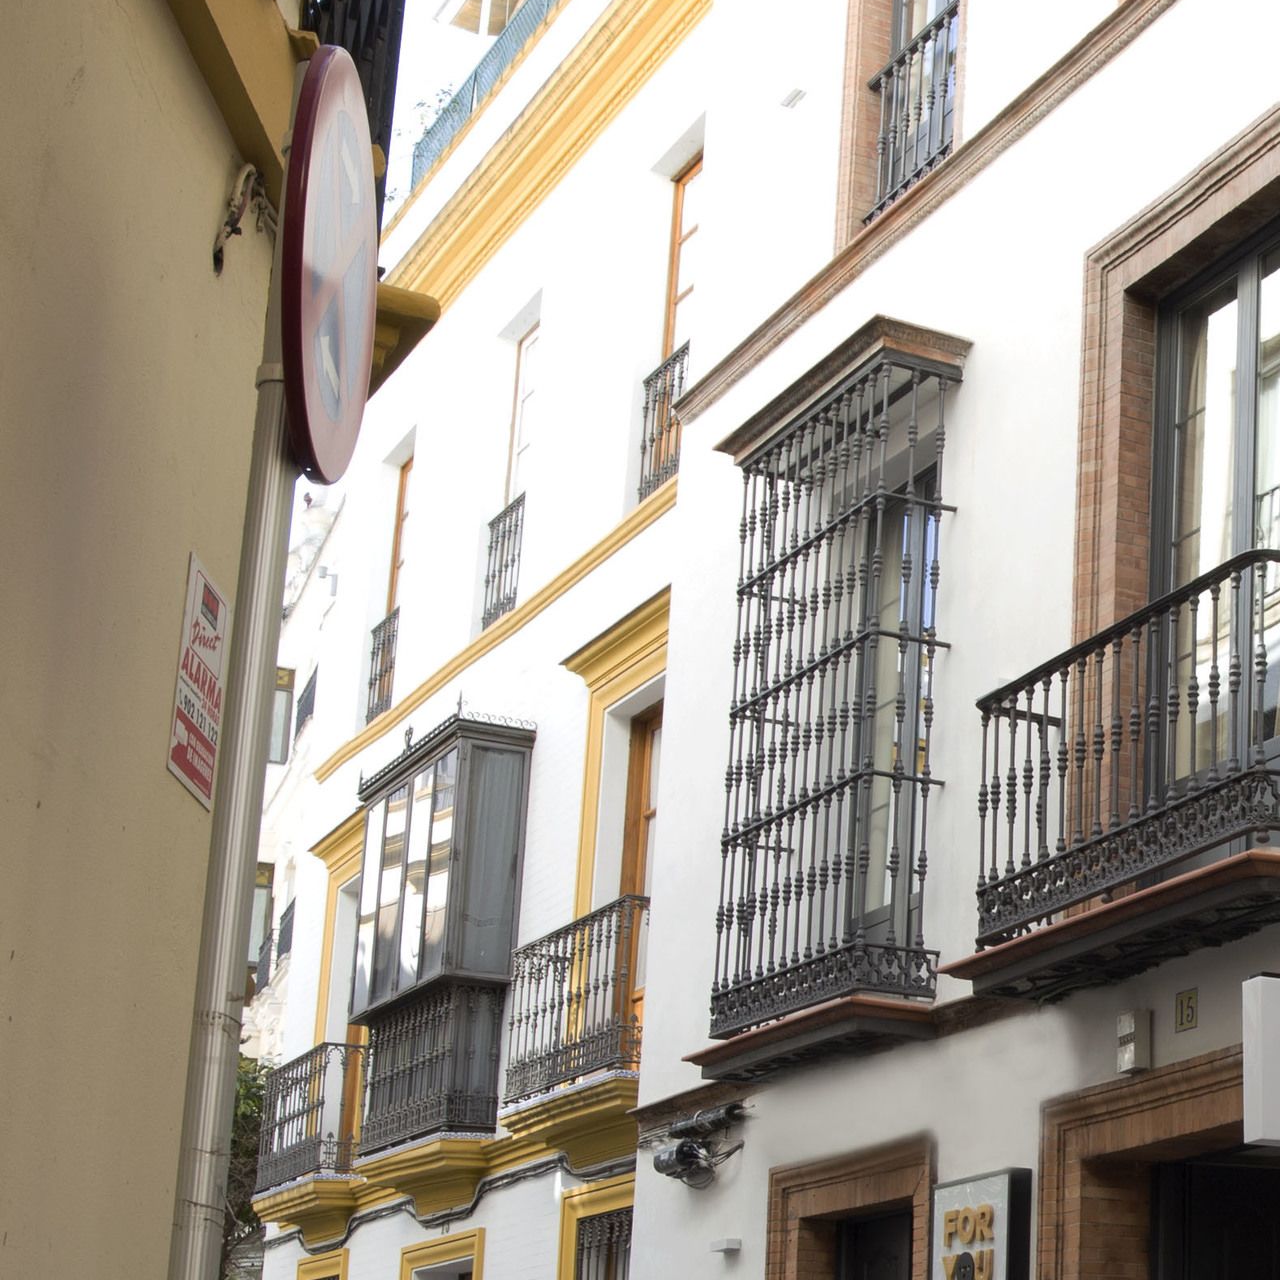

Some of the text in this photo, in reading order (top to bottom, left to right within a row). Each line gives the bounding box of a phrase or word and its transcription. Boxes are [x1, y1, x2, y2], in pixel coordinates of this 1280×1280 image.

[191, 617, 222, 652] Direct
[181, 646, 222, 713] ALARMA
[183, 694, 195, 720] 902
[196, 708, 207, 733] 121
[208, 721, 219, 747] 122
[1178, 995, 1195, 1026] 15
[943, 1203, 995, 1249] FOR
